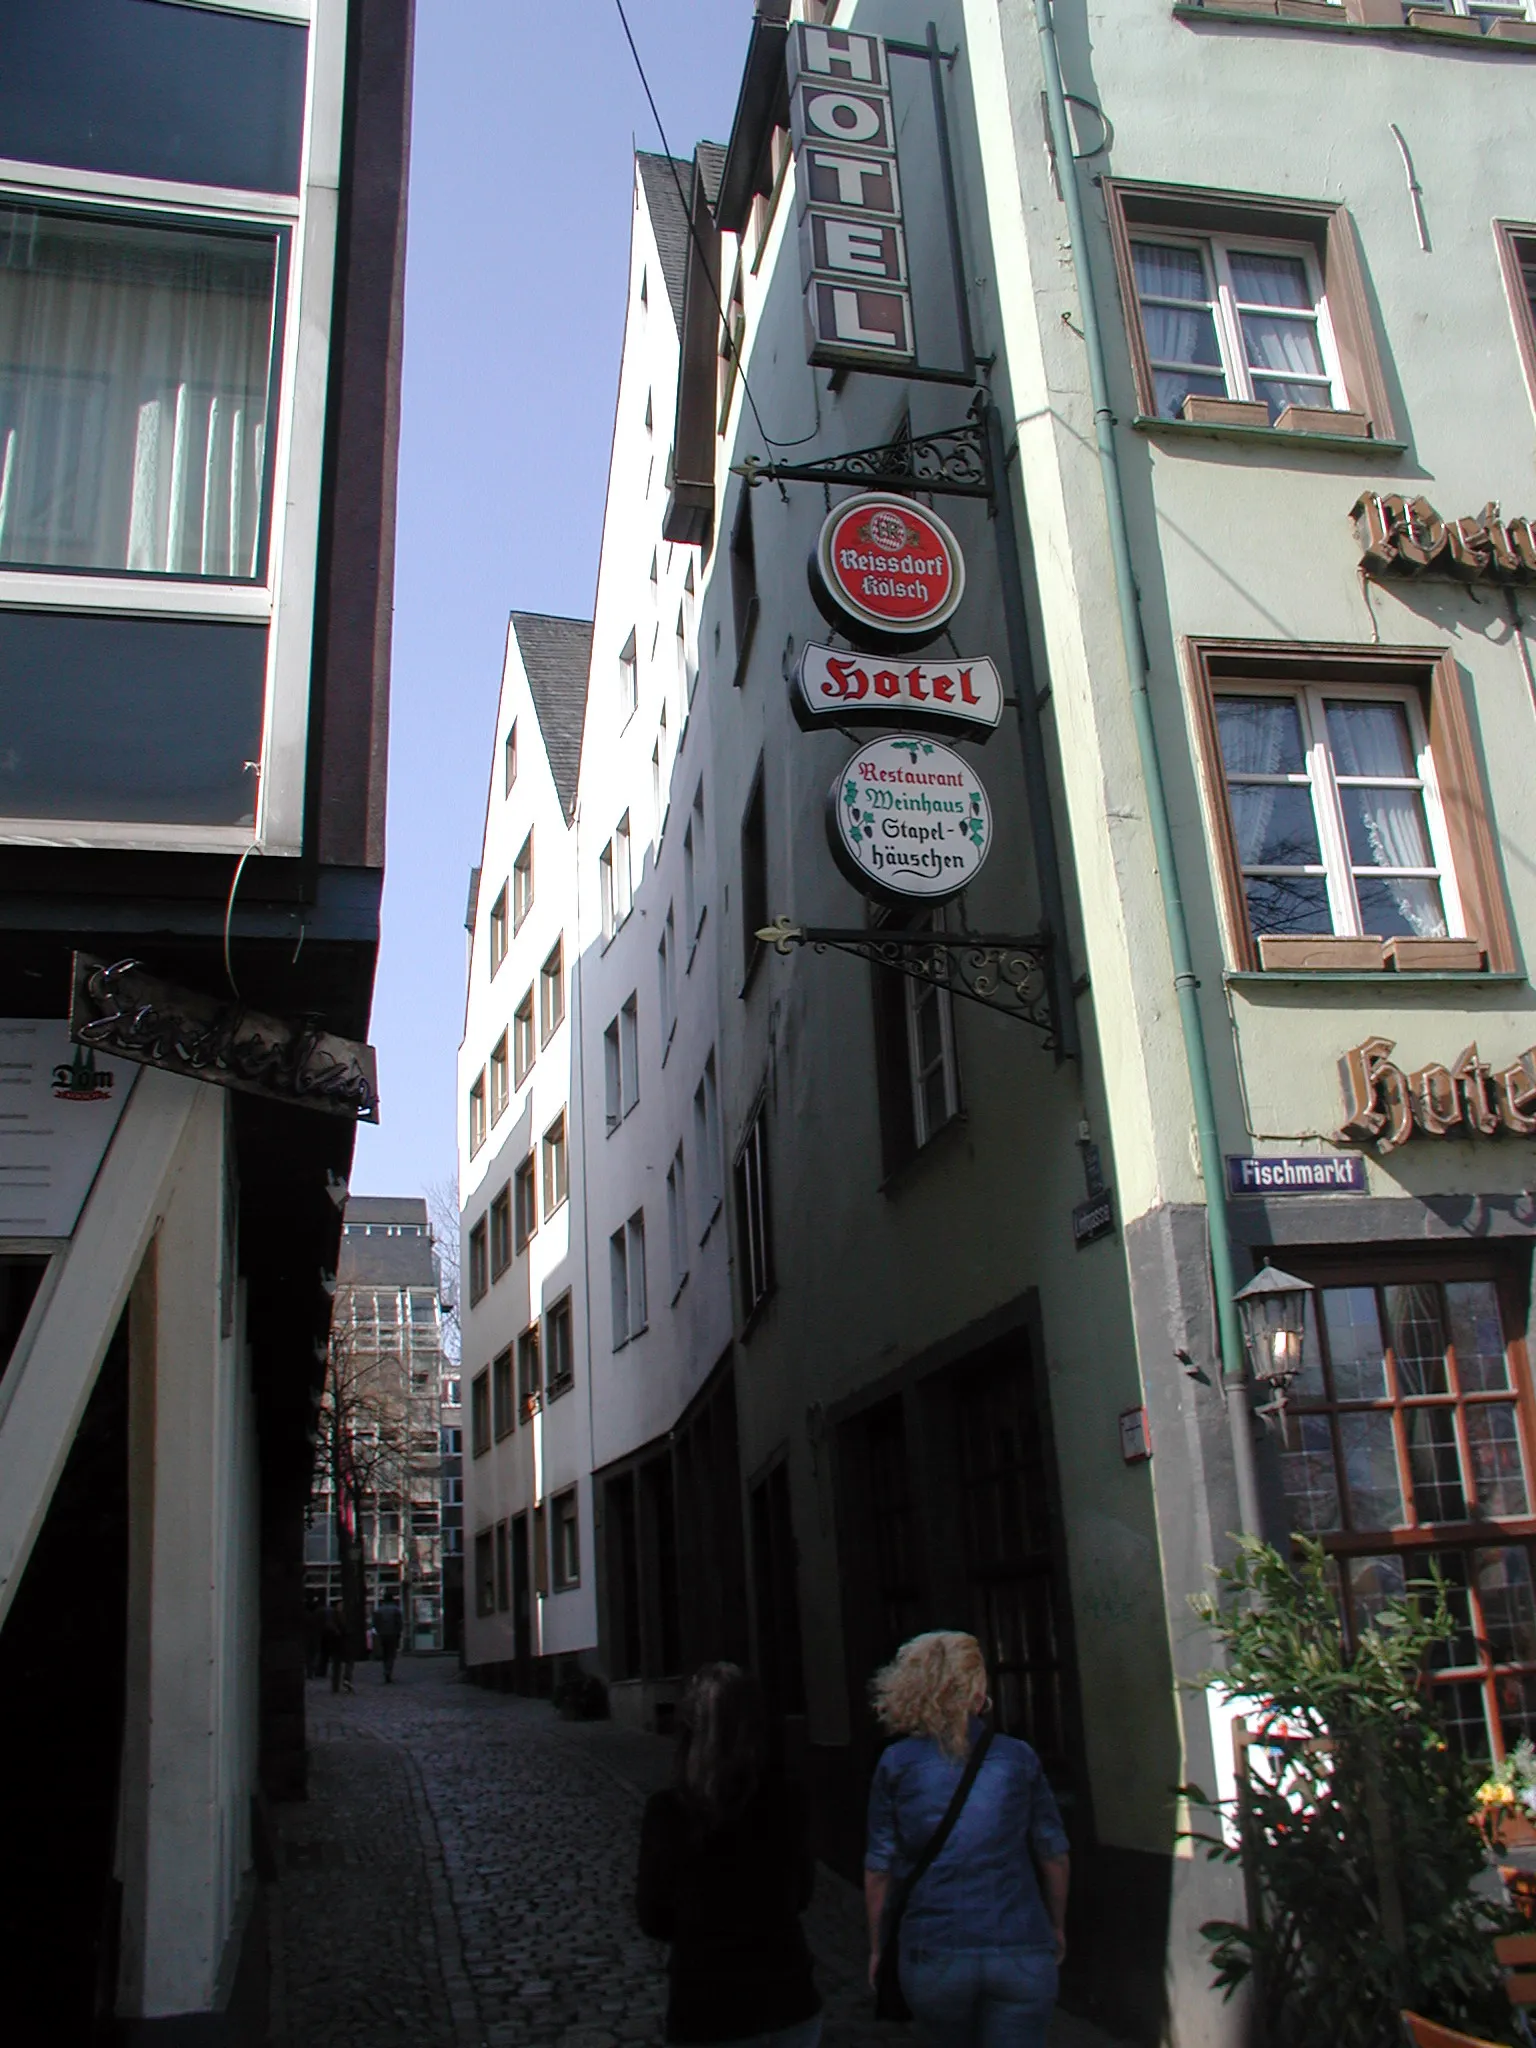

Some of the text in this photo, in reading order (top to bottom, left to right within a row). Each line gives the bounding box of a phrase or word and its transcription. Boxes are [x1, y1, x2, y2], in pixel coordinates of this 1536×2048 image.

[804, 27, 896, 347] HOTEL
[840, 549, 943, 576] Reissdorf
[861, 575, 929, 603] Kölsch
[820, 657, 981, 705] Hotel
[858, 762, 965, 787] Restaurant
[865, 788, 964, 816] Weinhaus
[882, 818, 954, 844] Stapel-
[872, 844, 965, 879] häuschen
[51, 1064, 114, 1088] Dom
[1336, 1036, 1536, 1154] Hote
[1241, 1158, 1354, 1186] Fischmarkt
